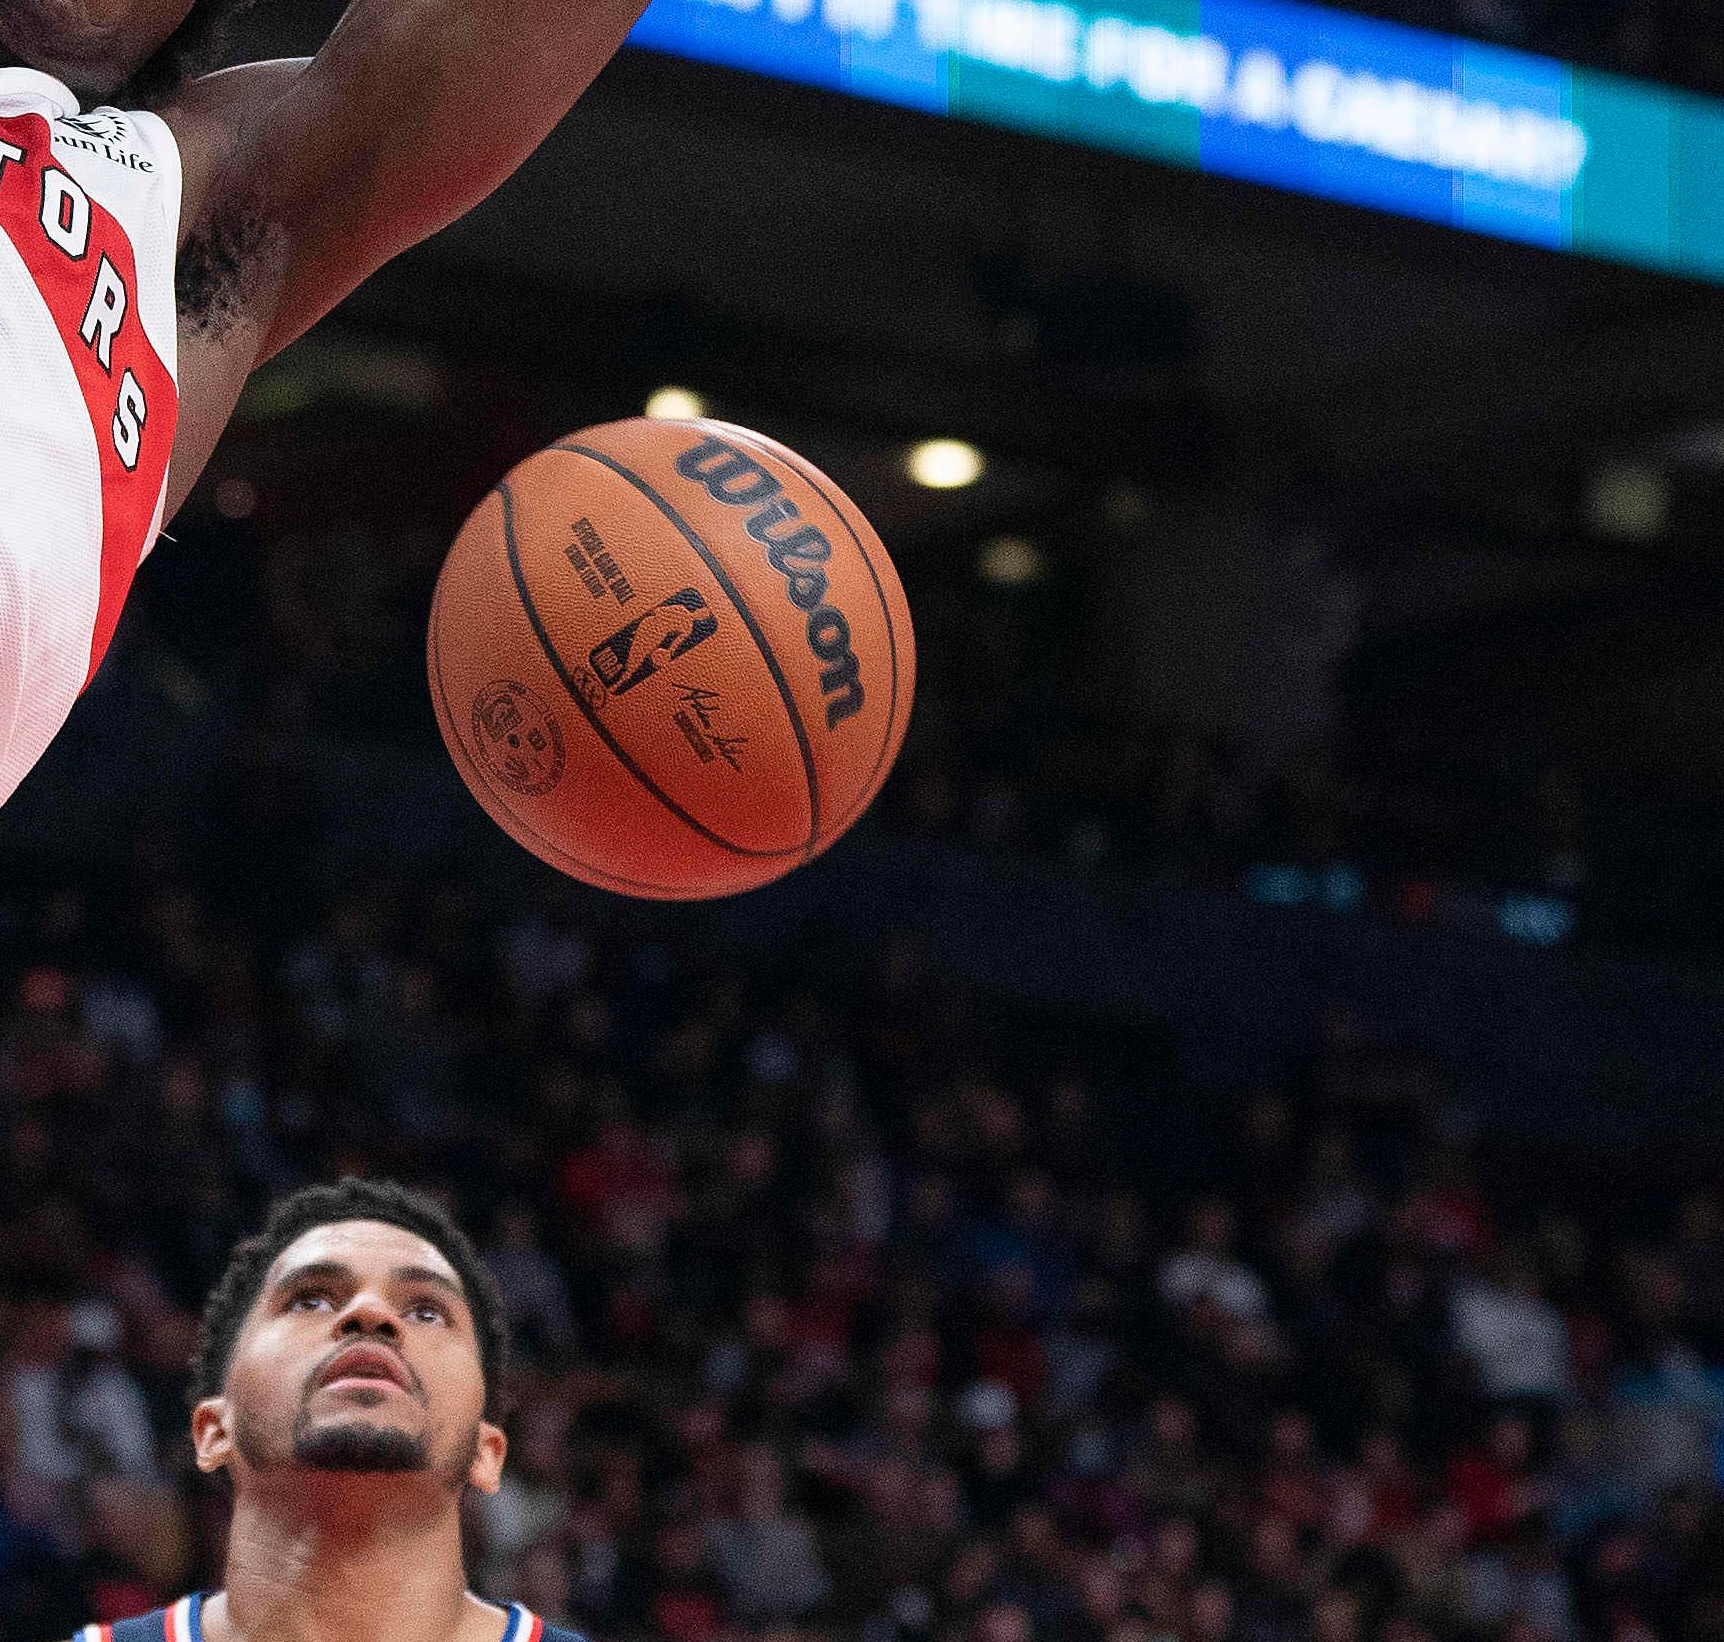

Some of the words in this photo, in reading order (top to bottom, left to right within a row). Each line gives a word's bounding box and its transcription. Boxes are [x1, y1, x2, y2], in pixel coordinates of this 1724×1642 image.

[54, 135, 98, 154] un
[102, 143, 155, 174] Life
[674, 435, 868, 732] Wilson
